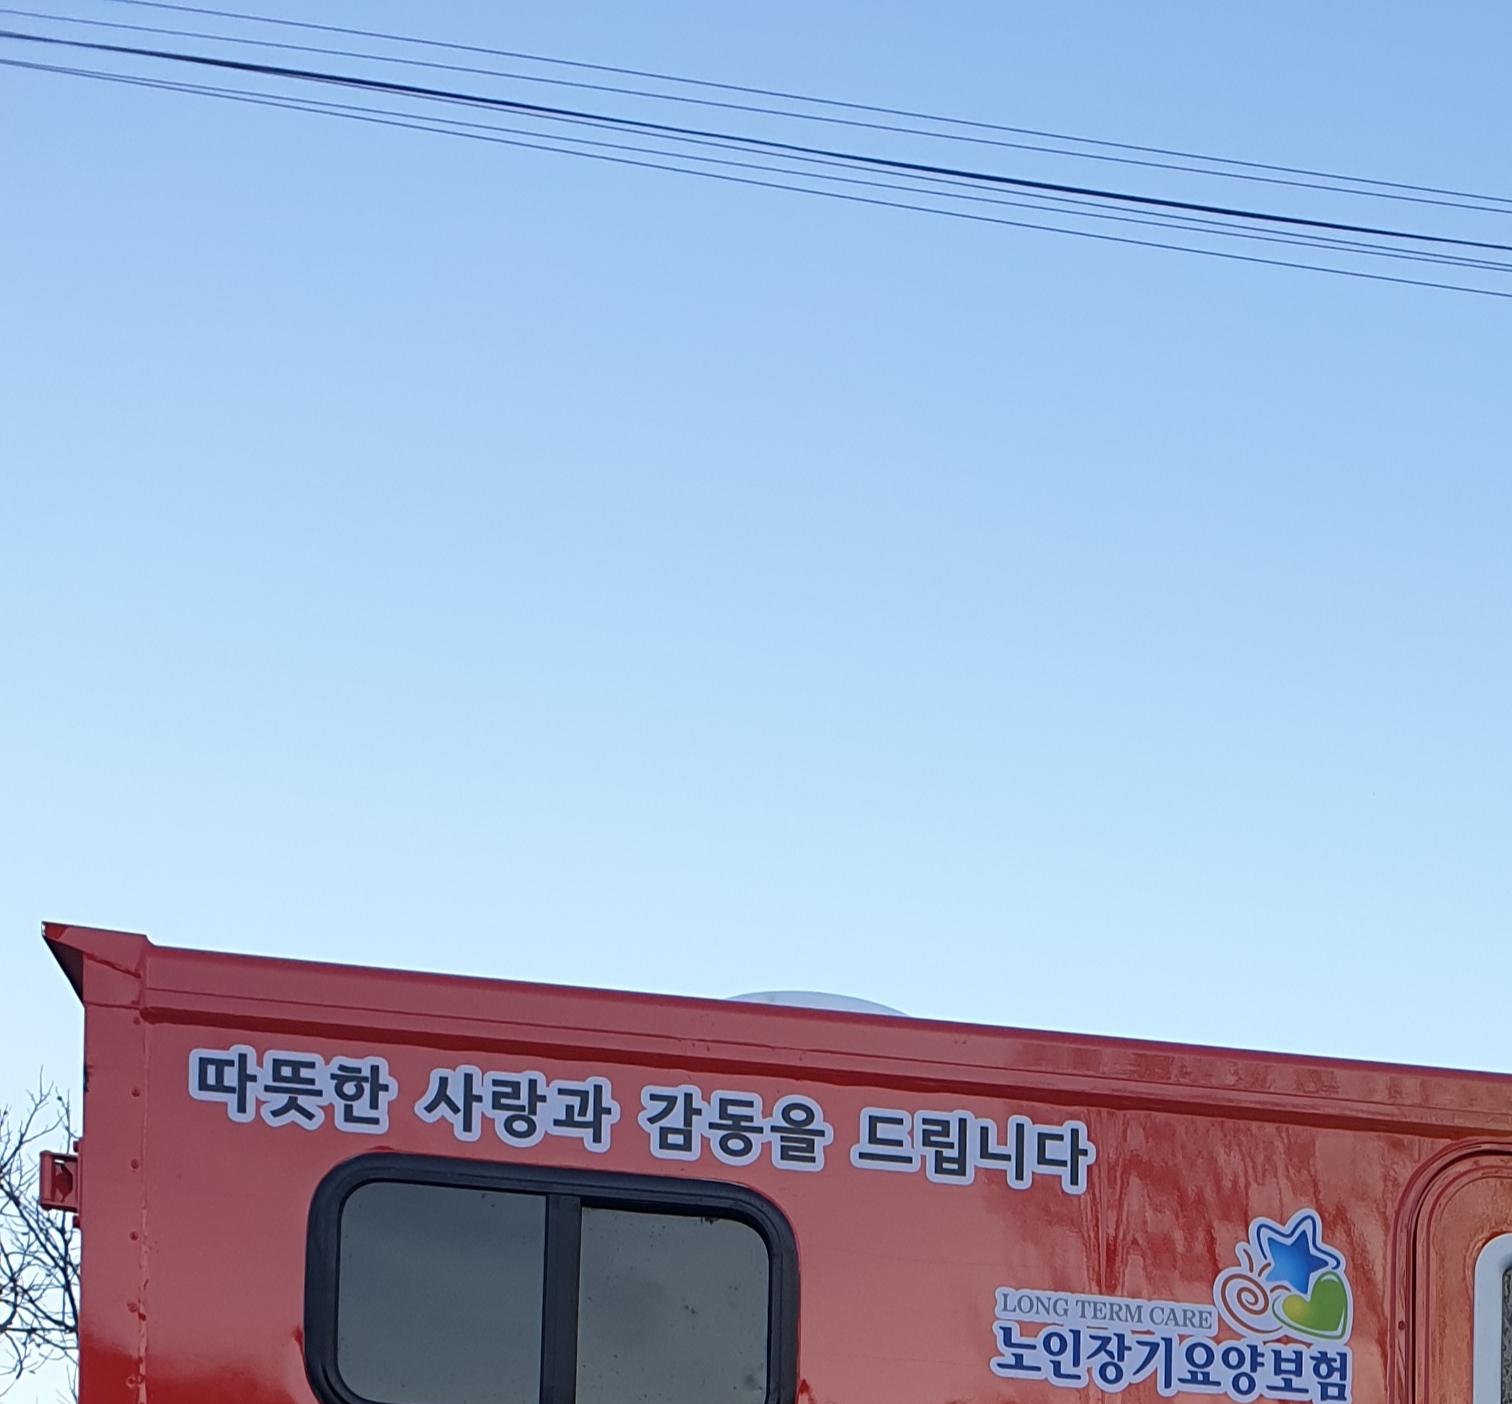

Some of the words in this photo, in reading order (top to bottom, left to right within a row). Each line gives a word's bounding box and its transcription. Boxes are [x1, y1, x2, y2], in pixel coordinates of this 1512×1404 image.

[197, 1051, 390, 1126] 따뜻한
[423, 1068, 613, 1147] 사랑과
[646, 1088, 827, 1164] 감동을
[858, 1112, 1090, 1190] 드립니다
[1001, 1292, 1069, 1317] LONG
[1075, 1299, 1144, 1324] TERM
[1149, 1305, 1213, 1330] CARE
[996, 1326, 1348, 1402] 노인장기요양보험
